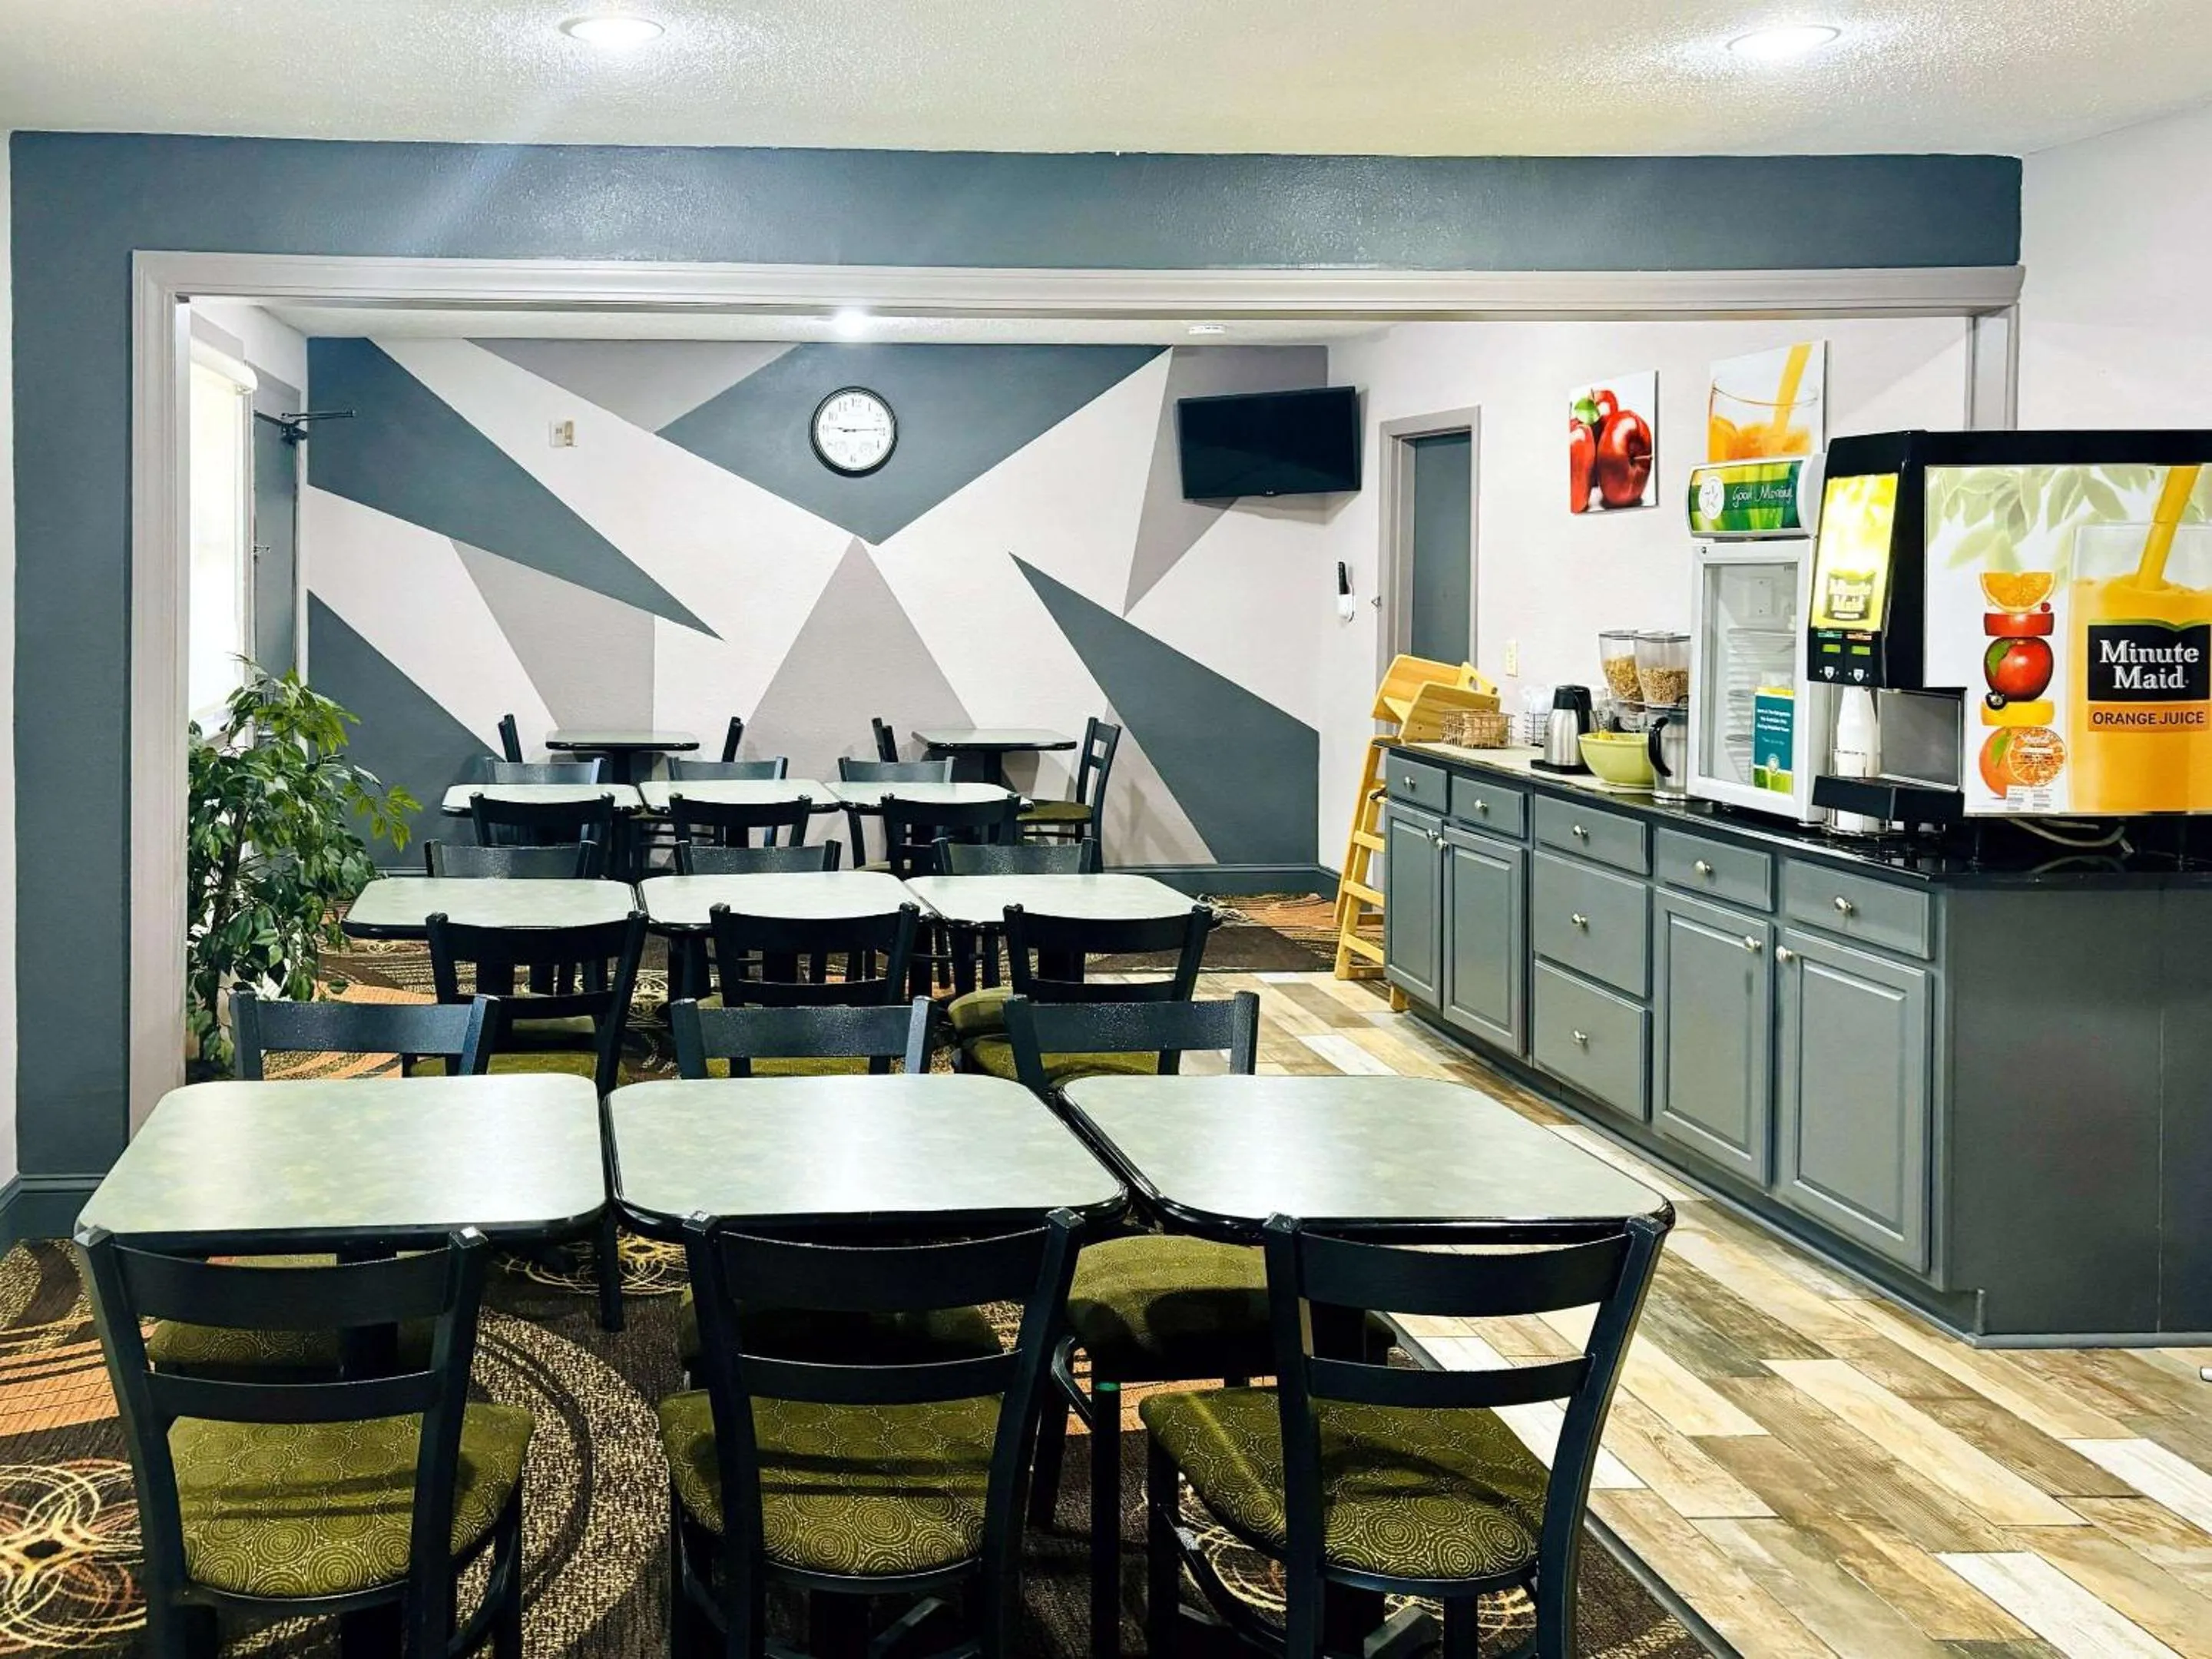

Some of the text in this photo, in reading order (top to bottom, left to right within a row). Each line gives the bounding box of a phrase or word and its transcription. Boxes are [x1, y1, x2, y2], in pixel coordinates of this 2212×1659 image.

[1732, 483, 1793, 508] Good Morning
[2099, 639, 2200, 663] Minute
[2113, 664, 2186, 689] Maid
[2092, 711, 2205, 725] ORANGE JUICE
